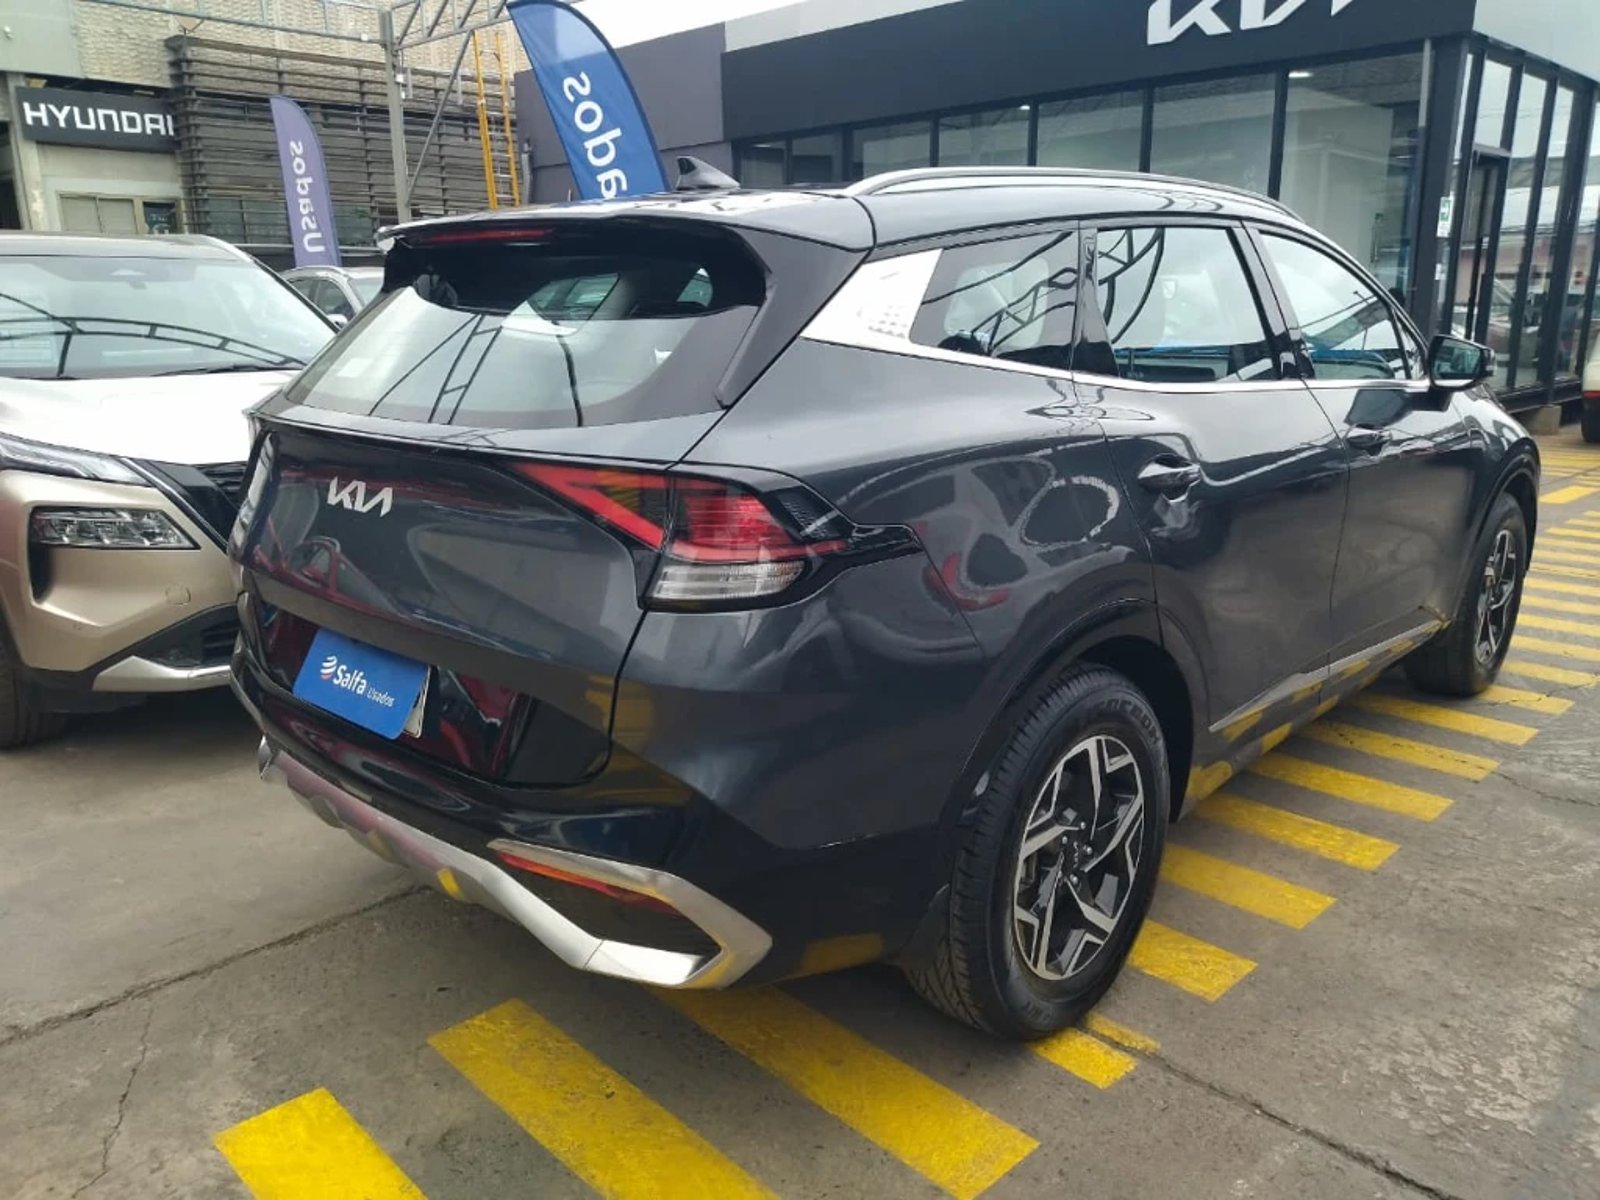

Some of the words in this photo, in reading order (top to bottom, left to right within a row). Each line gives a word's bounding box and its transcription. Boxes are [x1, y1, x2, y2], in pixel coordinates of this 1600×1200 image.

[1147, 0, 1352, 46] KI
[22, 101, 175, 136] HYUNDAI
[326, 475, 393, 518] KIA
[333, 664, 367, 695] Salfa
